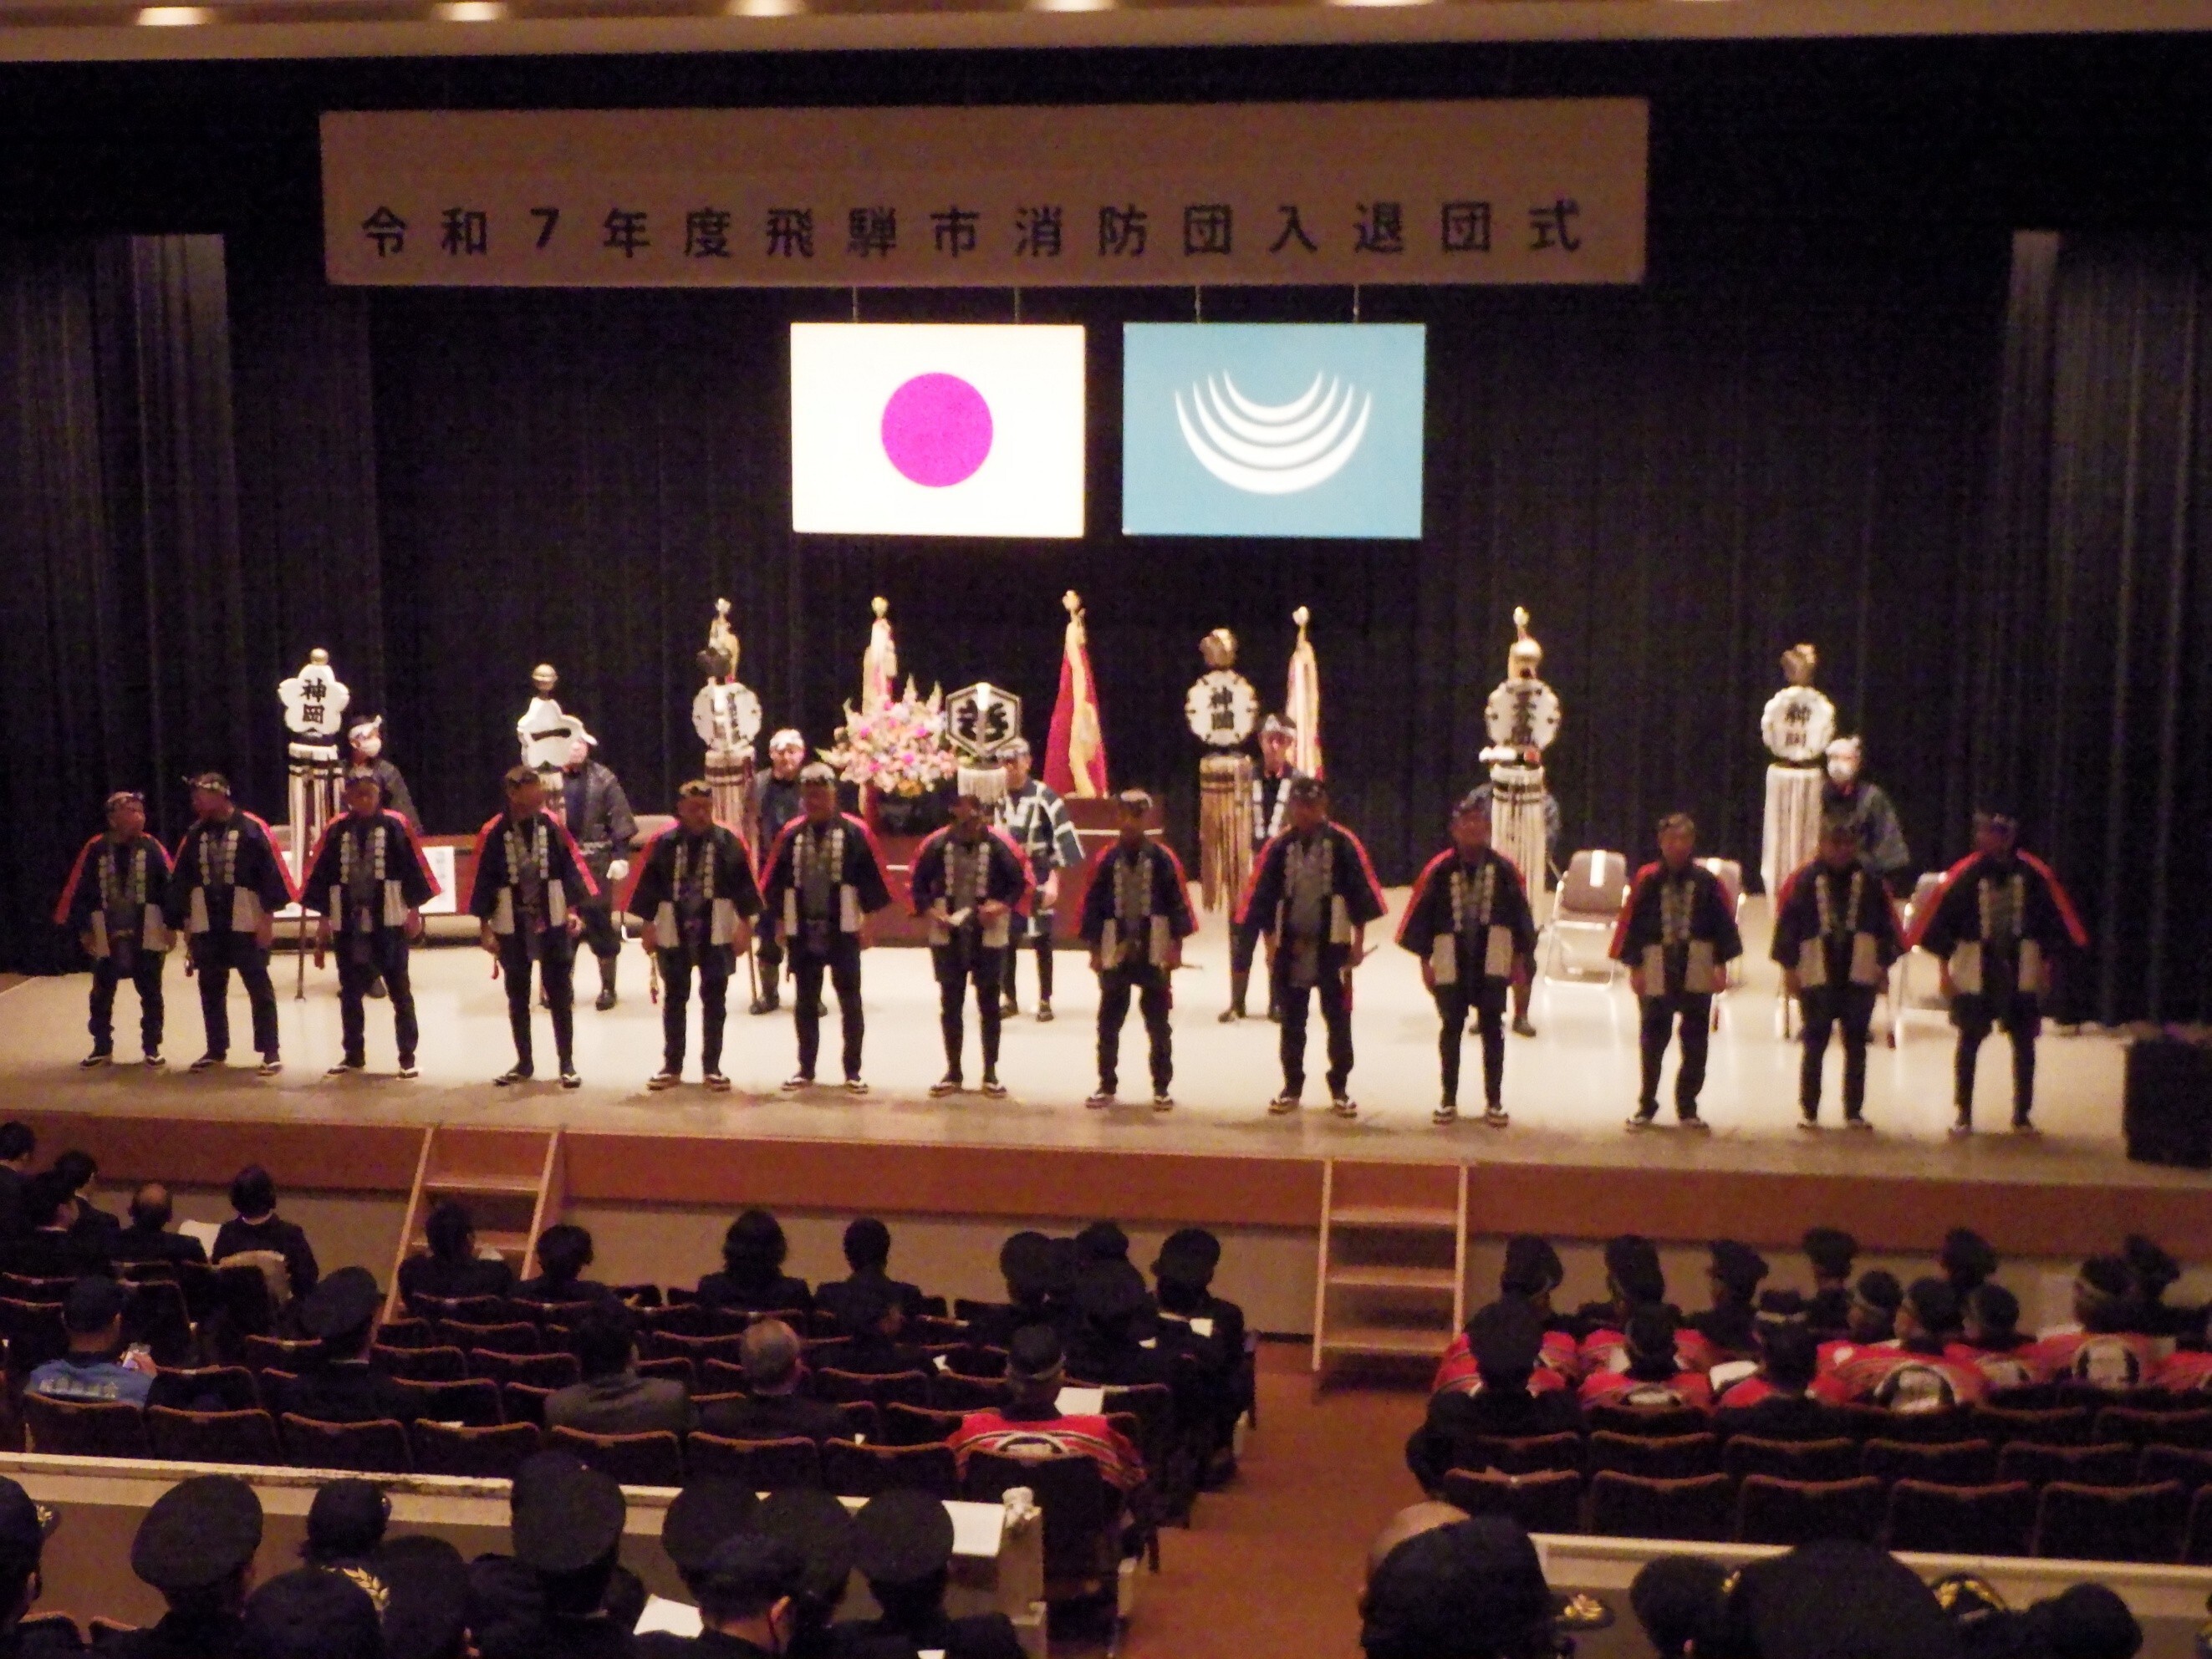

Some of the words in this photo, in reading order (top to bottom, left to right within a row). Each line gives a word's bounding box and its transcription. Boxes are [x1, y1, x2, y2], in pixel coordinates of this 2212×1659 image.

[362, 199, 1583, 258] 令和7年度飛騨市消防団入退団式
[300, 677, 327, 724] 神岡
